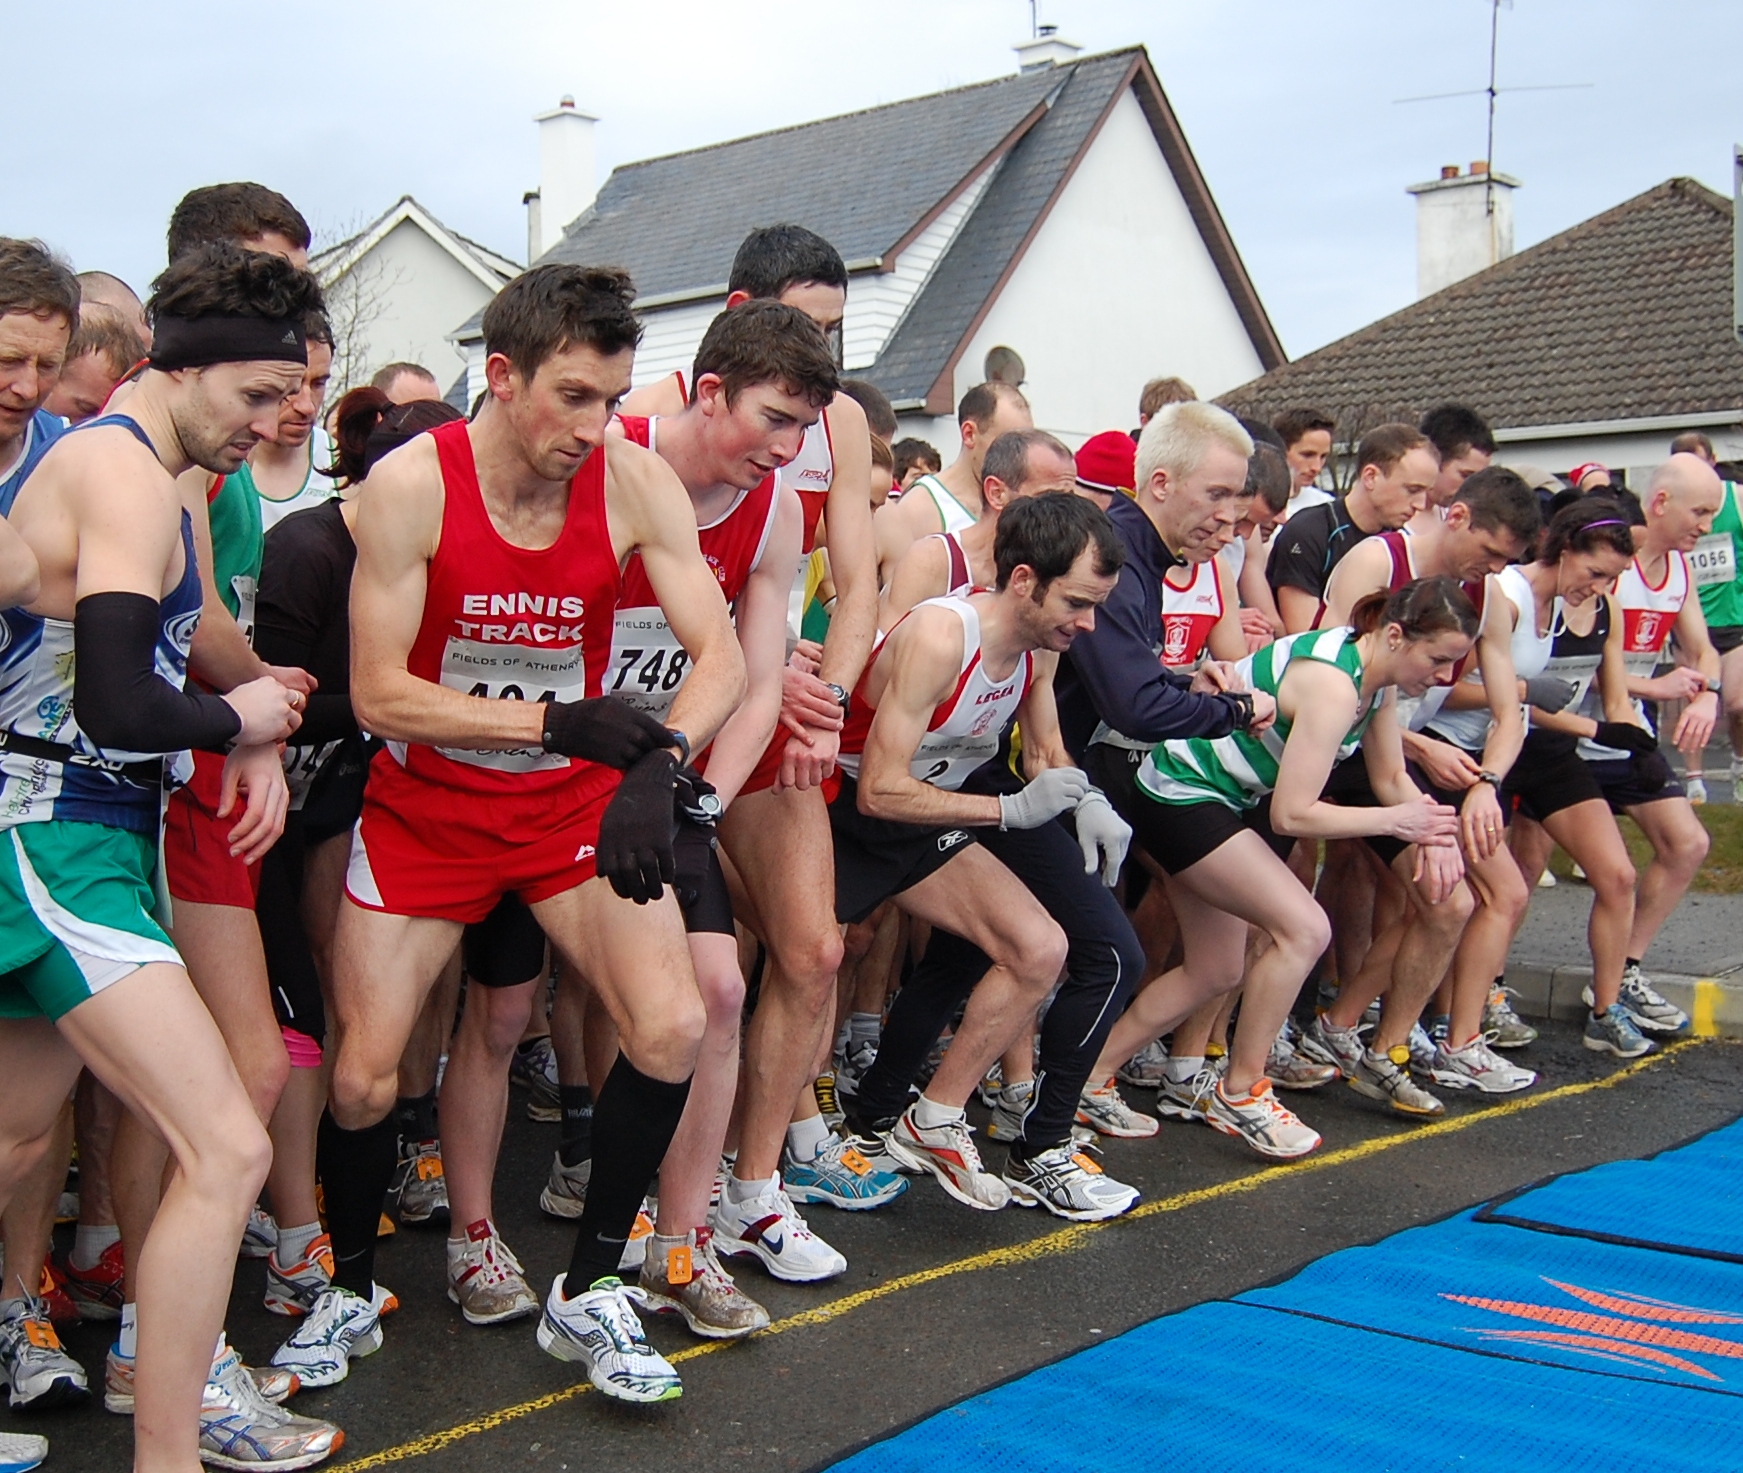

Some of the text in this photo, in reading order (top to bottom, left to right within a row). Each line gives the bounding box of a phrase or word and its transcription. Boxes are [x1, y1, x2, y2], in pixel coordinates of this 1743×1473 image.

[462, 591, 585, 618] ENNIS
[454, 619, 586, 643] TRACK
[615, 620, 652, 630] FIELDS
[451, 652, 580, 672] FIELDS OF ATHENRY
[612, 648, 689, 692] 748
